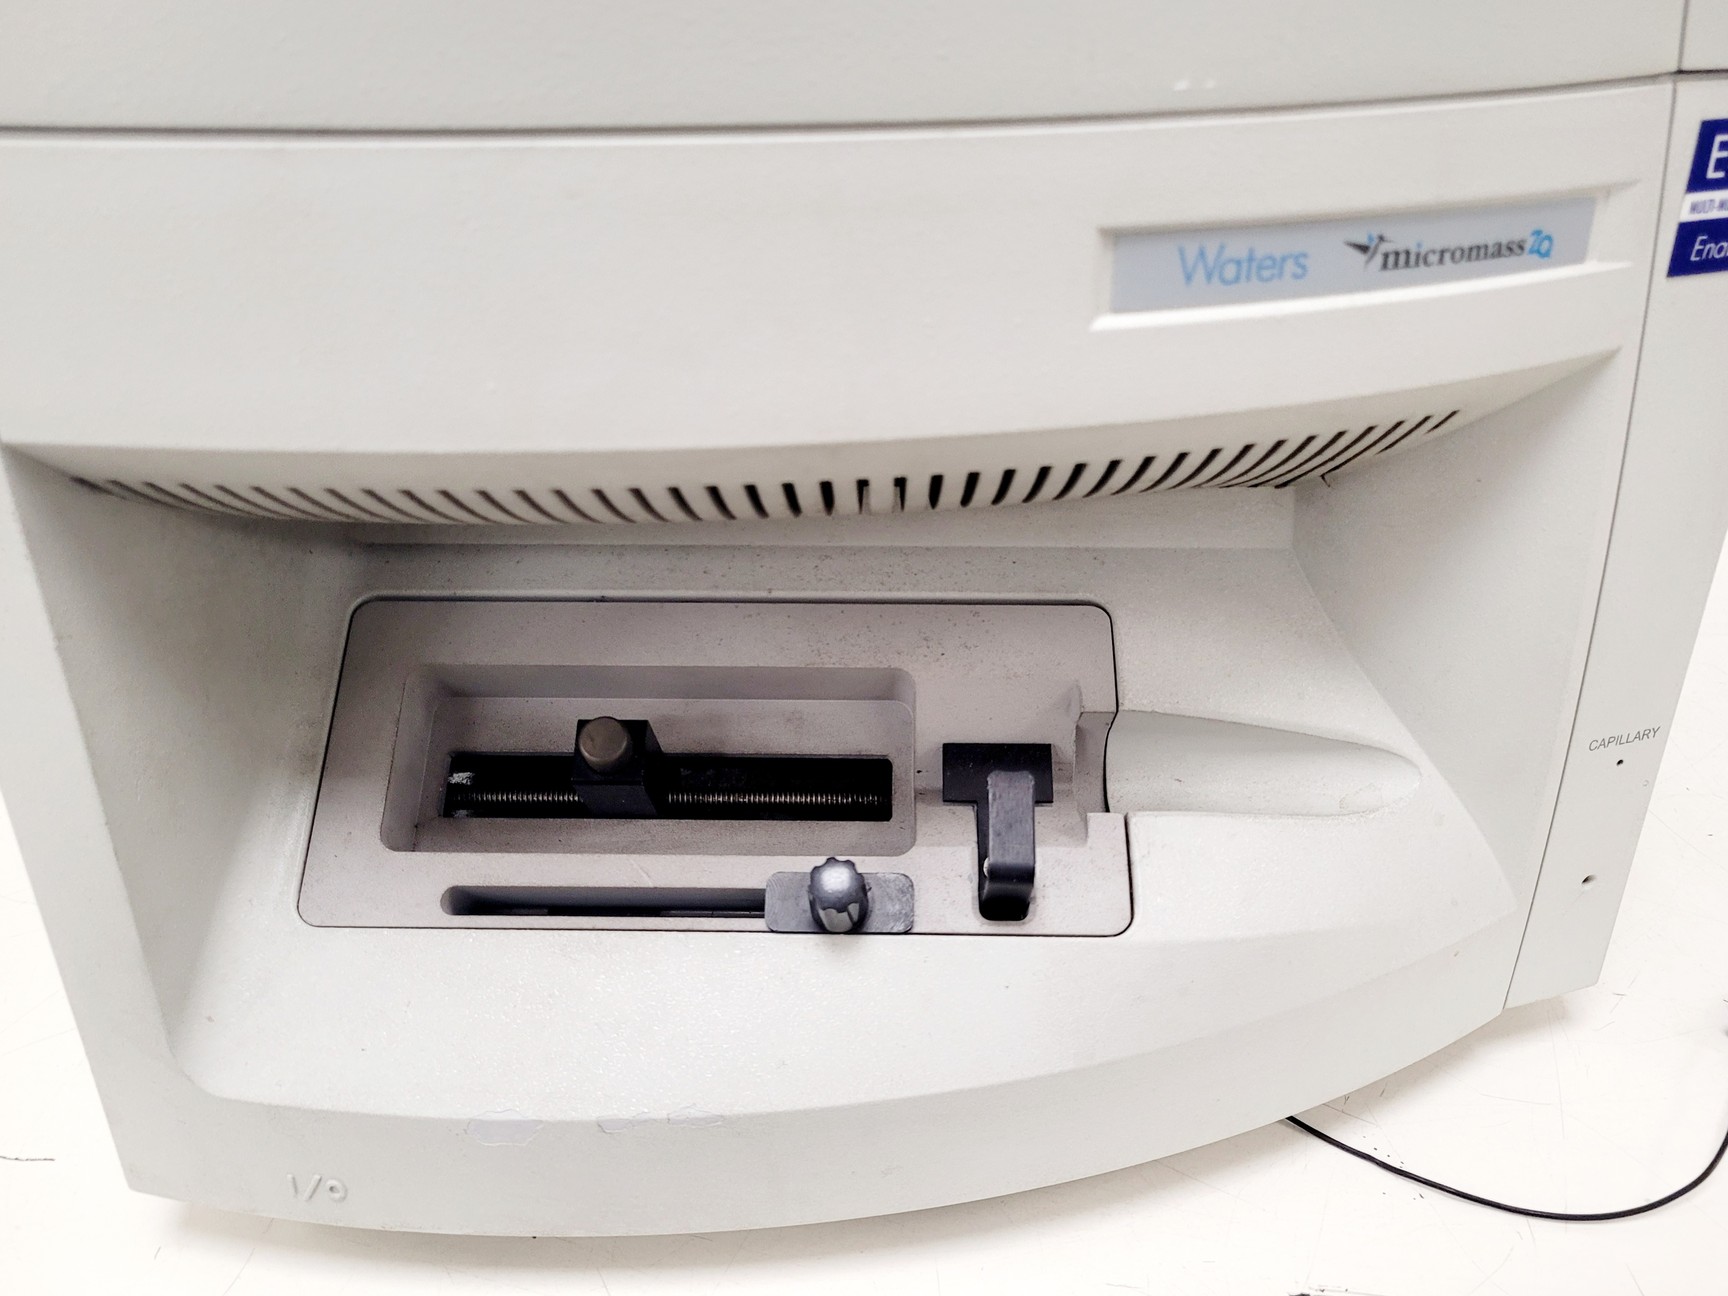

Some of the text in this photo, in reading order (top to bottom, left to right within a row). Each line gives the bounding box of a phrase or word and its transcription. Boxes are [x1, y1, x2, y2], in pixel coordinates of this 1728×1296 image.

[1690, 235, 1728, 261] Ena
[1178, 243, 1309, 286] Waters
[1588, 726, 1661, 751] CAPILLARY
